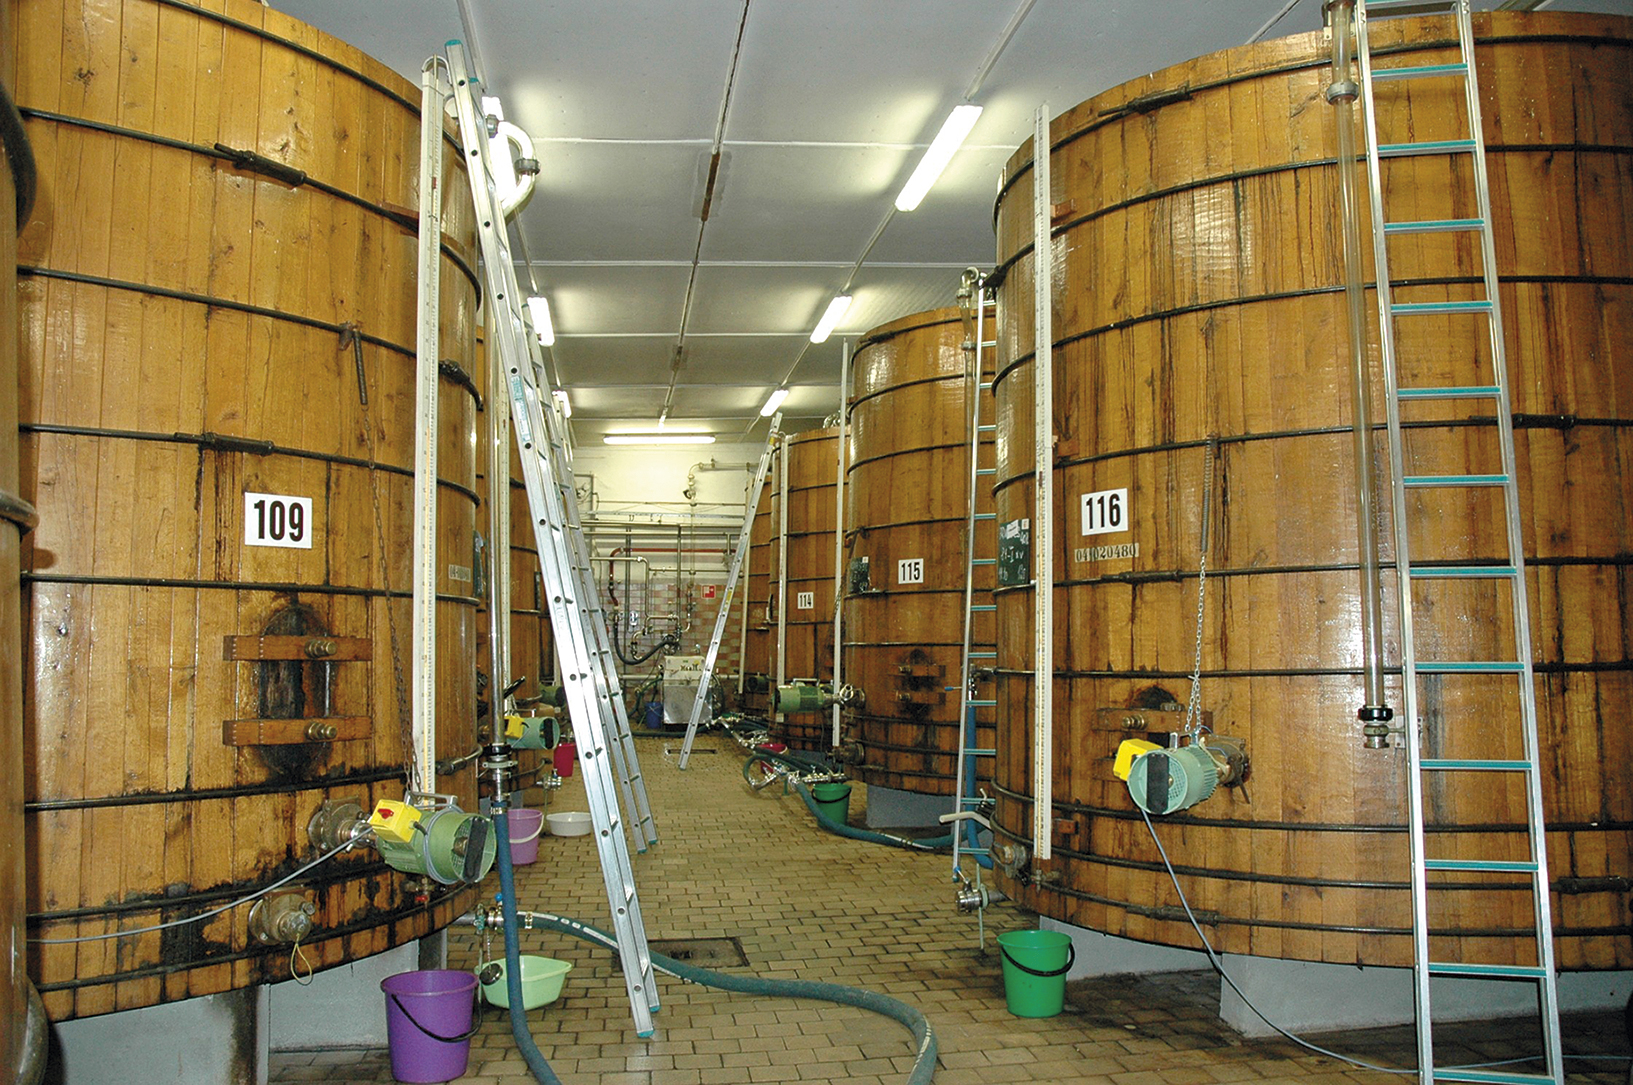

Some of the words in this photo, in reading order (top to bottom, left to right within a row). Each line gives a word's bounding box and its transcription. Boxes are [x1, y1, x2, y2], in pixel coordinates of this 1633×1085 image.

[254, 500, 304, 542] 109
[1086, 493, 1121, 529] 116
[901, 562, 920, 581] 115
[800, 594, 811, 607] 114
